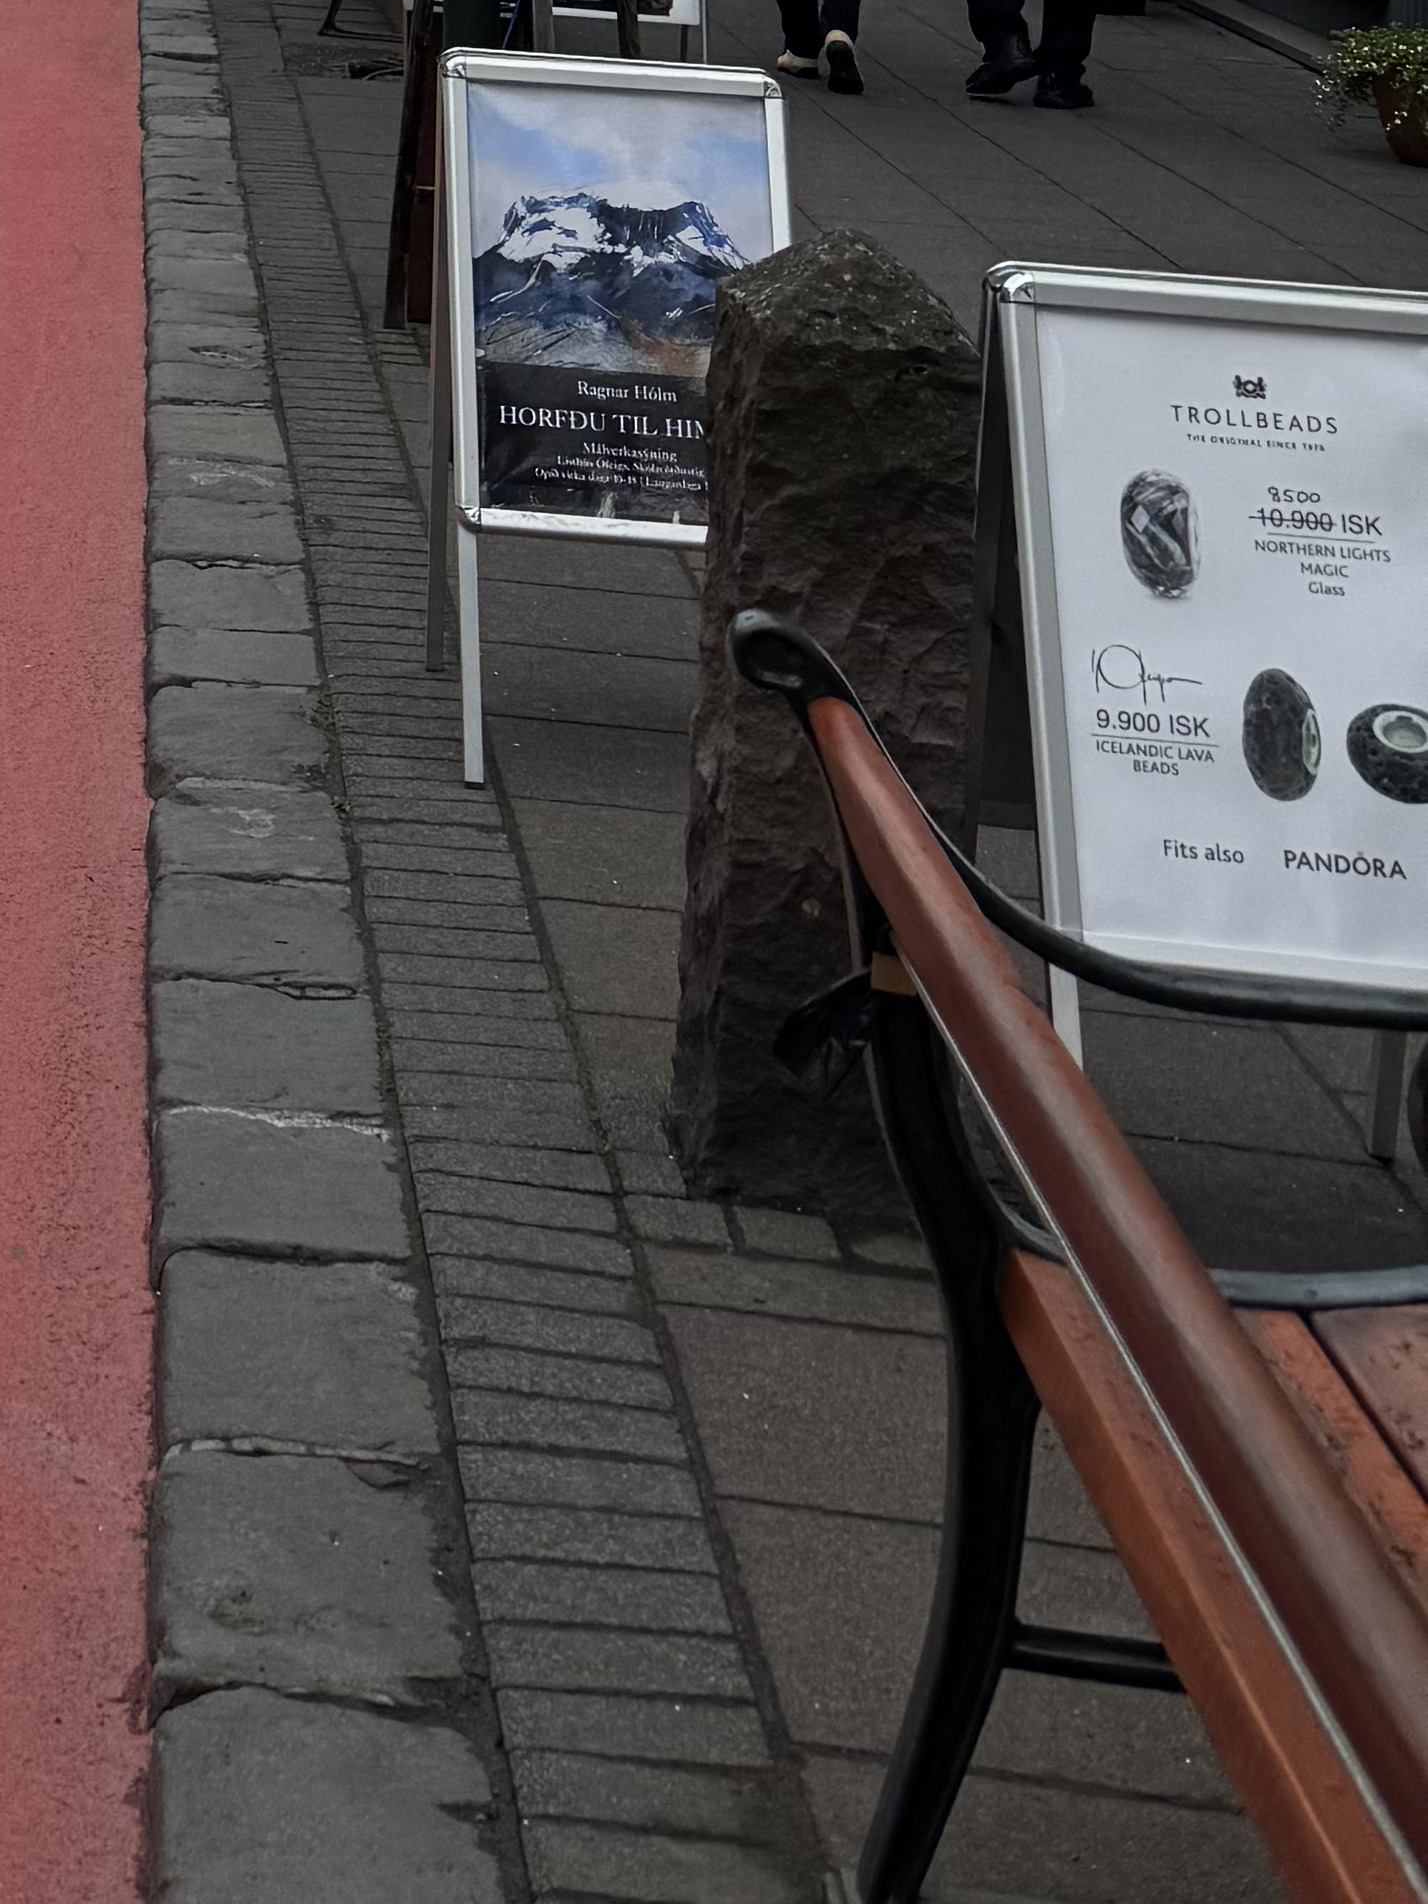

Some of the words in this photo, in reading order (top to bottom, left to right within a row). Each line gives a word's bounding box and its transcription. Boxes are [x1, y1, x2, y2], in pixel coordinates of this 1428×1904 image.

[578, 380, 629, 400] Ragnar
[634, 385, 678, 402] Hólm
[500, 405, 605, 431] HORFÐU
[613, 415, 657, 435] TIL
[1170, 405, 1337, 434] TROLLBEADS
[1268, 486, 1321, 503] 8500
[1342, 514, 1383, 536] ISK
[1254, 539, 1336, 558] NORTHERN
[1340, 543, 1391, 563] LIGHTS
[1300, 563, 1349, 578] MAGIC
[1308, 581, 1345, 597] Glass
[1096, 708, 1161, 733] 9.900
[1169, 714, 1210, 738] ISK
[1096, 739, 1174, 759] ICELANDIC
[1178, 747, 1215, 763] LAVA
[1133, 759, 1179, 776] BEADS
[1163, 839, 1198, 860] Fits
[1204, 843, 1244, 864] also
[1284, 850, 1407, 880] PANDORA
